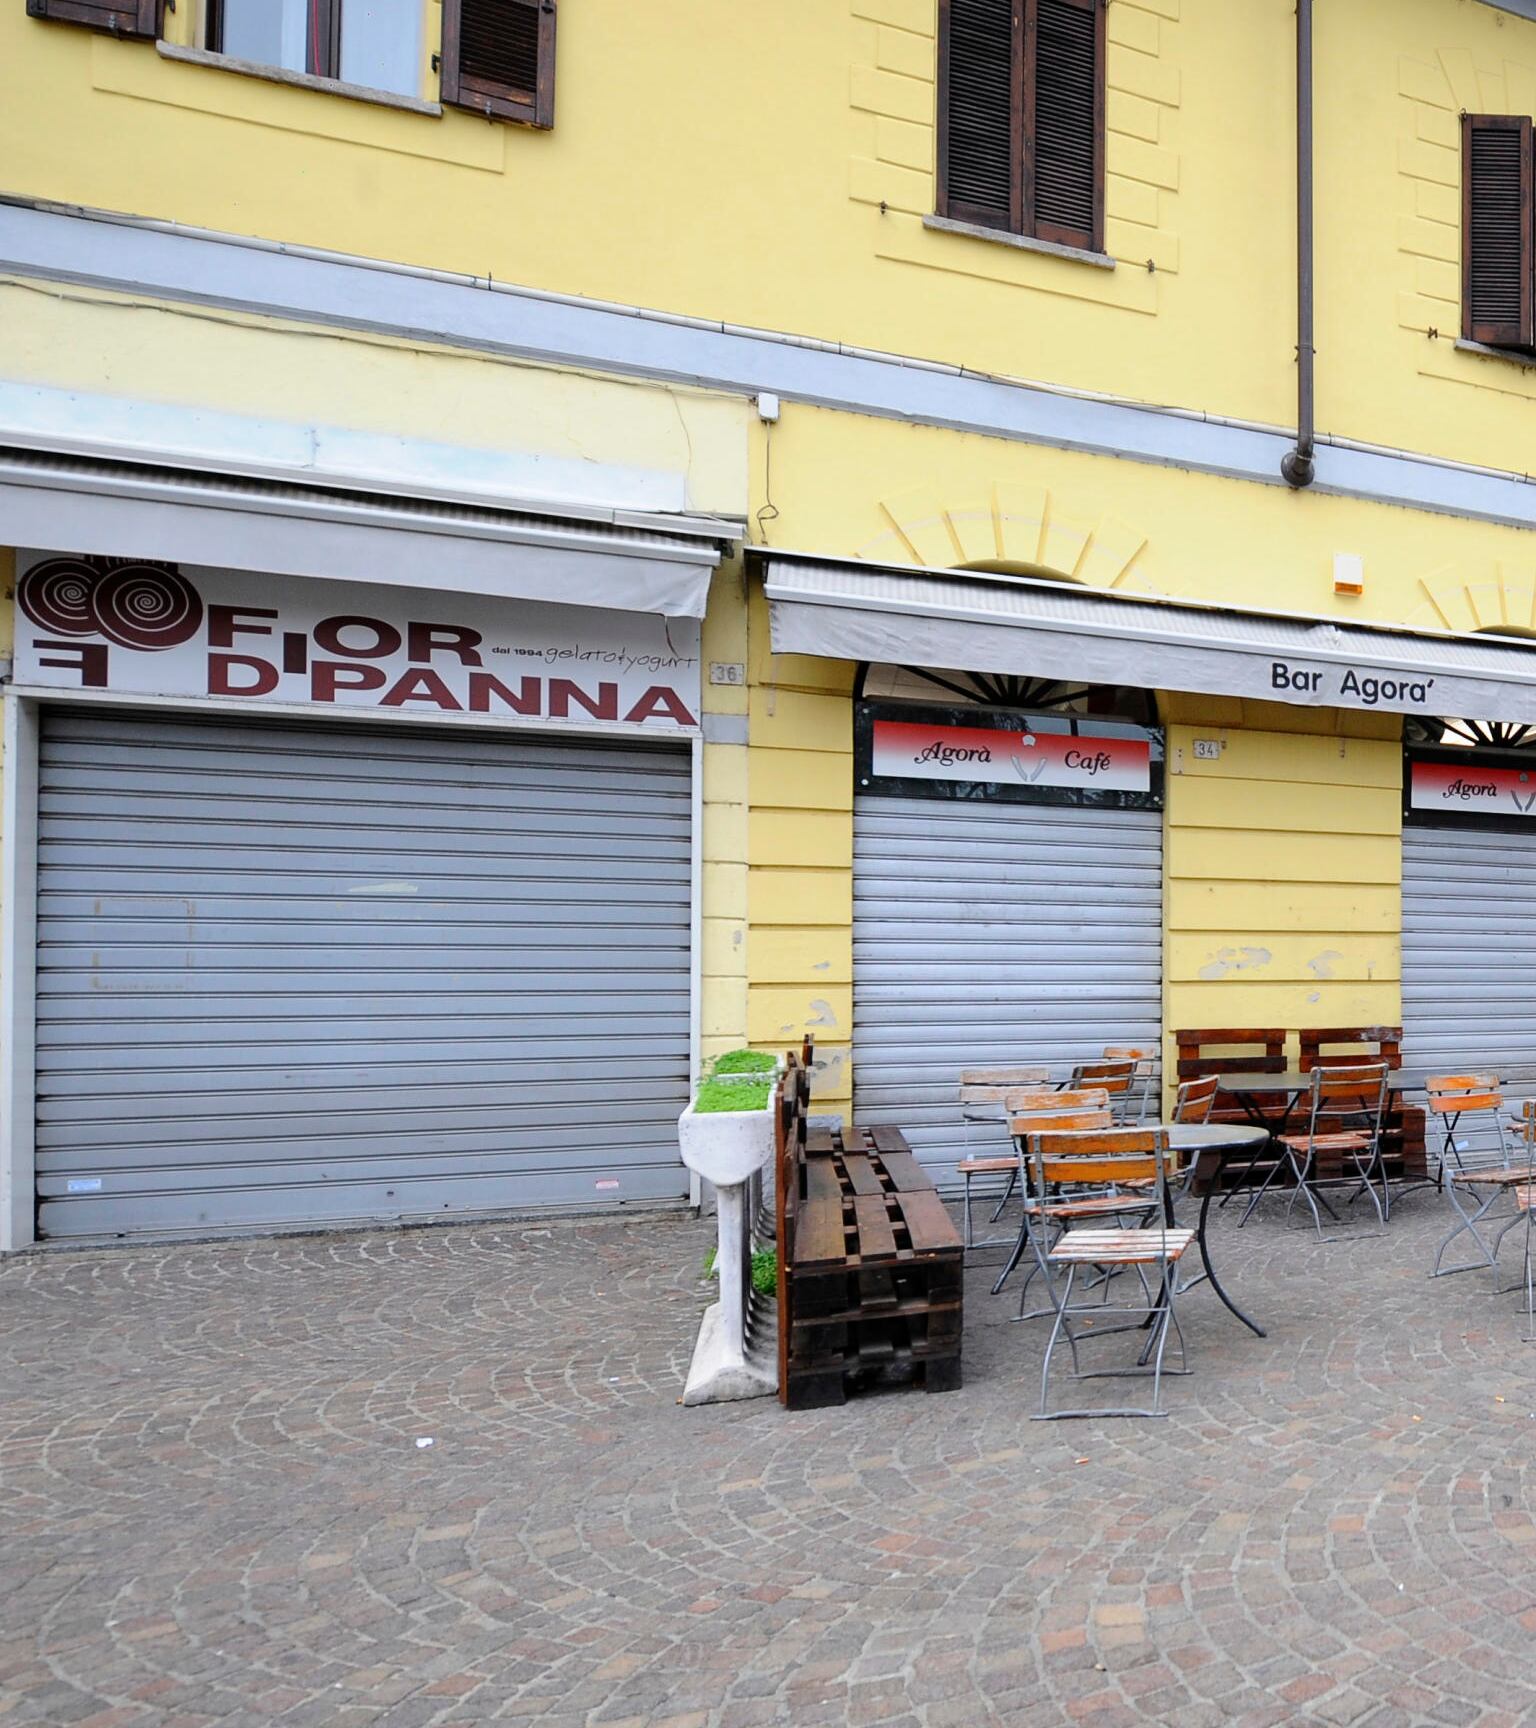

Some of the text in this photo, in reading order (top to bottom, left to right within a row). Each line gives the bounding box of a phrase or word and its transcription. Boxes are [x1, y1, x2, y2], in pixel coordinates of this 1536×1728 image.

[207, 604, 483, 675] FIOR
[491, 647, 510, 655] dal
[515, 648, 543, 657] 1994
[716, 665, 737, 682] 36
[1271, 662, 1323, 692] Bar
[914, 741, 1112, 776] Agorà Café
[1198, 741, 1216, 757] 34
[1443, 779, 1498, 801] Agorà
